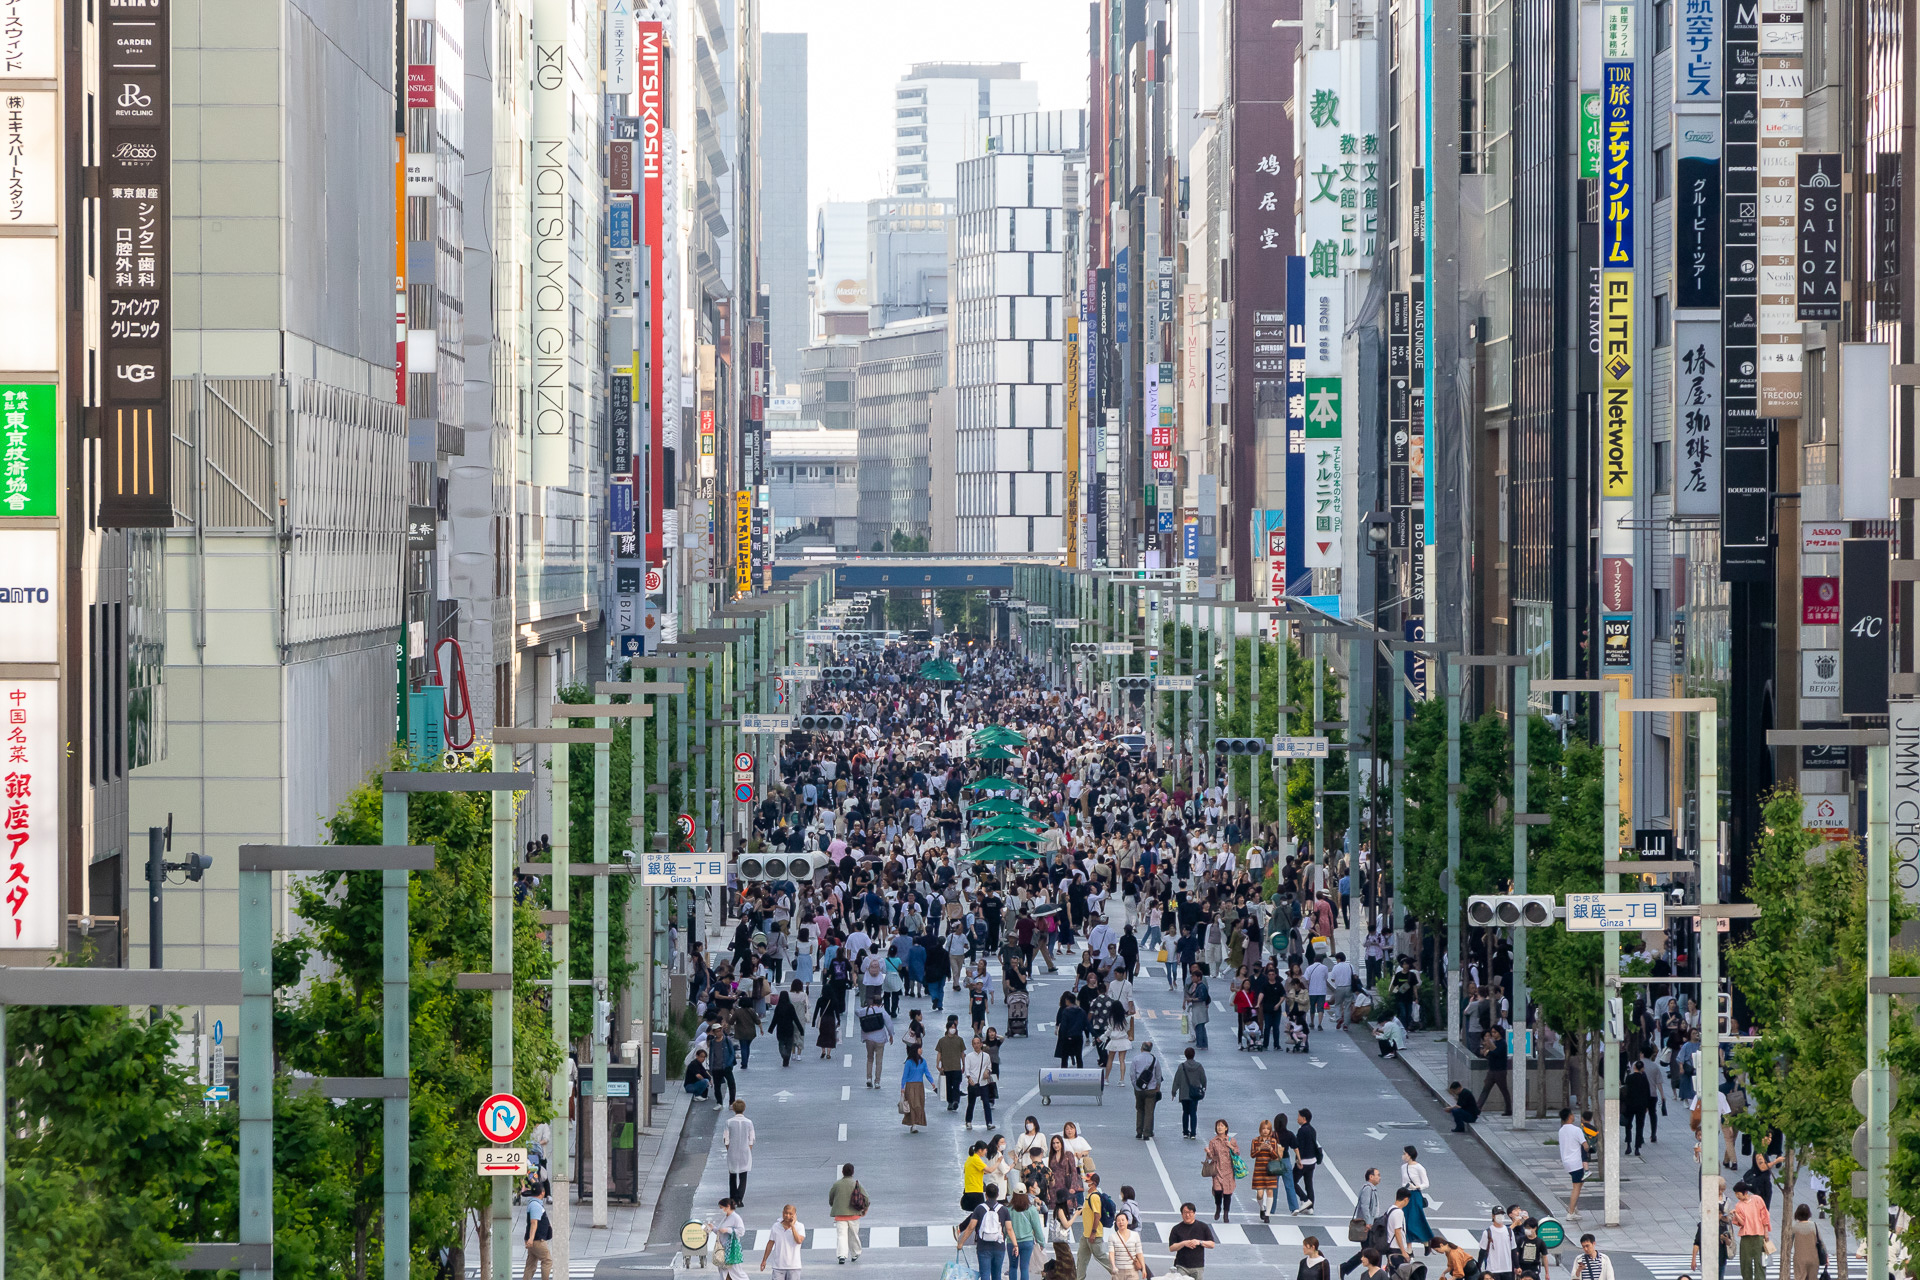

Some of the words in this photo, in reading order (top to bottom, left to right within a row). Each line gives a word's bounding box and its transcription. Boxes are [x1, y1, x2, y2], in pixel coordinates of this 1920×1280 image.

[1780, 13, 1791, 23] 8F
[614, 20, 625, 84] 三幸エステート
[1780, 60, 1791, 69] 8F
[643, 32, 659, 178] MITSUKOSHI
[1780, 99, 1790, 108] 7F
[1779, 138, 1790, 147] 6F
[112, 188, 158, 199] 東京銀座
[1309, 89, 1340, 279] 教文館
[1339, 133, 1358, 257] 教文館ビル
[1779, 178, 1789, 187] 6F
[612, 211, 620, 247] イーオン
[1779, 217, 1789, 226] 5F
[116, 228, 133, 287] 口腔外科
[138, 202, 155, 287] シンタニ歯科
[1779, 256, 1789, 265] 5F
[1802, 198, 1816, 296] SALON
[1825, 198, 1837, 296] GINZA
[614, 260, 626, 304] ざくろ
[1117, 263, 1127, 332] 名鉄観光
[111, 299, 159, 316] ファインケア
[1319, 296, 1329, 332] SINCE
[1415, 300, 1424, 329] NAILS
[1609, 280, 1628, 355] ELITE
[1778, 296, 1789, 305] 4F
[111, 320, 160, 338] クリニック
[1779, 334, 1789, 344] 1F
[1215, 329, 1226, 395] TASAKI
[1415, 331, 1424, 369] UNIQUE
[117, 364, 155, 382] UGG
[1309, 387, 1338, 428] 本
[1682, 344, 1716, 493] 椿屋珈琲店
[1316, 450, 1331, 531] ナルニア国
[738, 506, 749, 584] ライオンビヤホール
[1188, 528, 1196, 556] PLAZA
[1415, 523, 1424, 548] BDC
[1415, 553, 1424, 601] PILATES
[1606, 624, 1629, 634] N9Y
[9, 688, 28, 763] 中国名菜
[744, 719, 789, 728] 銀座二丁目
[1277, 743, 1324, 751] 銀座二丁目
[1895, 717, 1920, 794] JIMMY
[4, 771, 32, 940] 銀座アスター
[1642, 836, 1666, 856] dunhill
[1895, 801, 1920, 889] CHOO
[647, 862, 721, 875] 銀座一丁目
[1573, 903, 1657, 919] 銀座一丁目
[1599, 919, 1624, 927] Ginza
